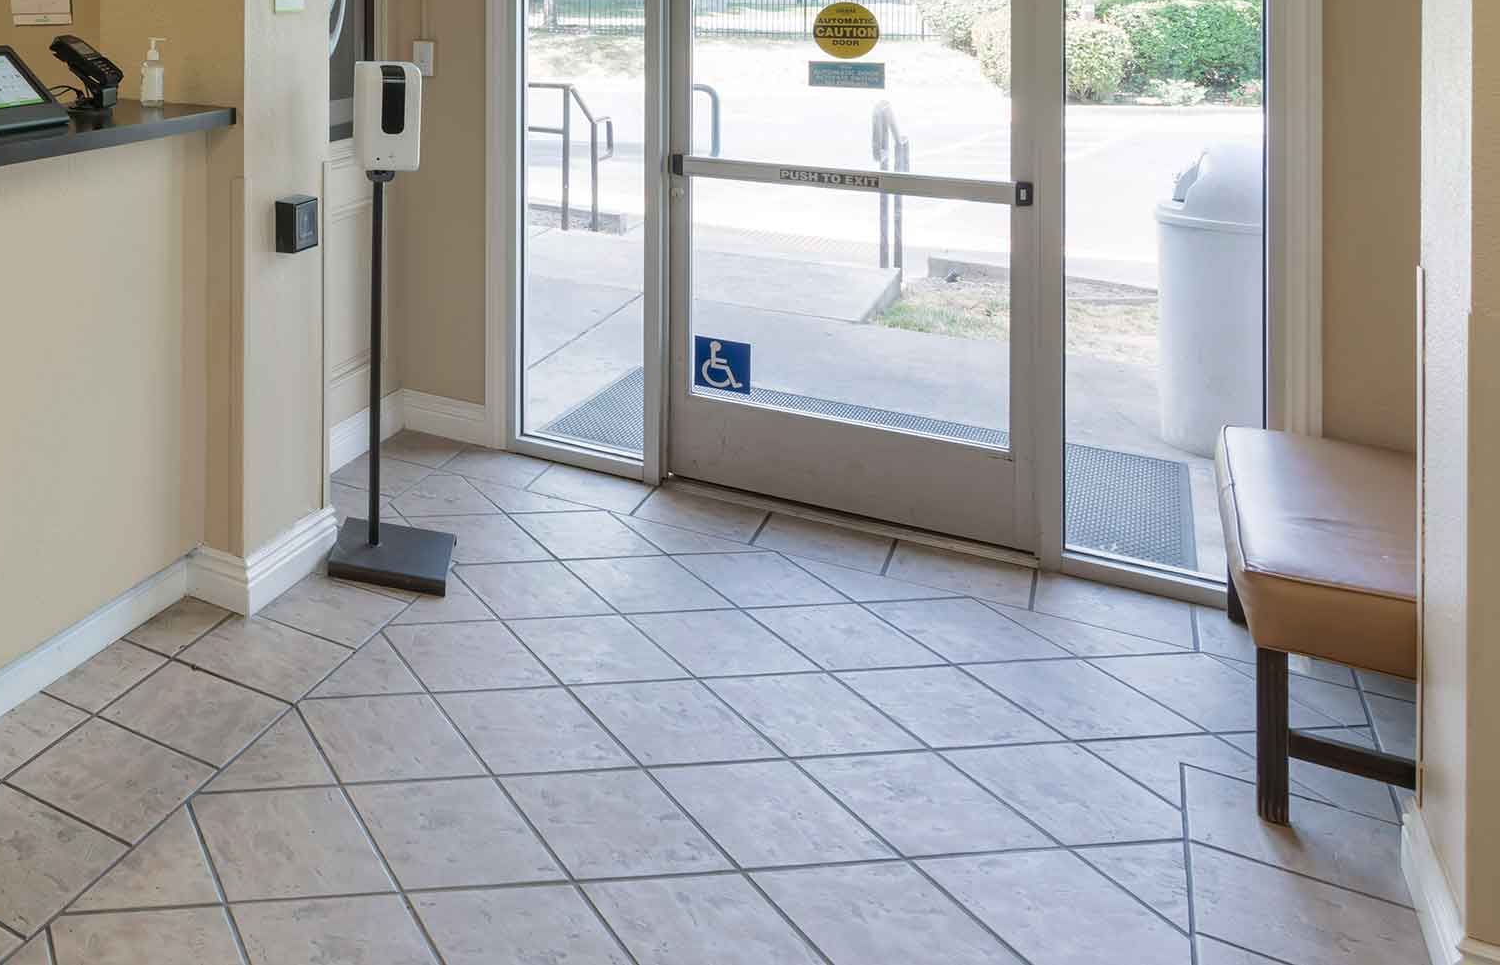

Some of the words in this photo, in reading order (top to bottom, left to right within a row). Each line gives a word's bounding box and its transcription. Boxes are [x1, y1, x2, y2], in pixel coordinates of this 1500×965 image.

[815, 27, 877, 37] CAUTION
[780, 170, 818, 182] PUSH
[820, 173, 841, 183] TO
[845, 174, 879, 187] EXIT
